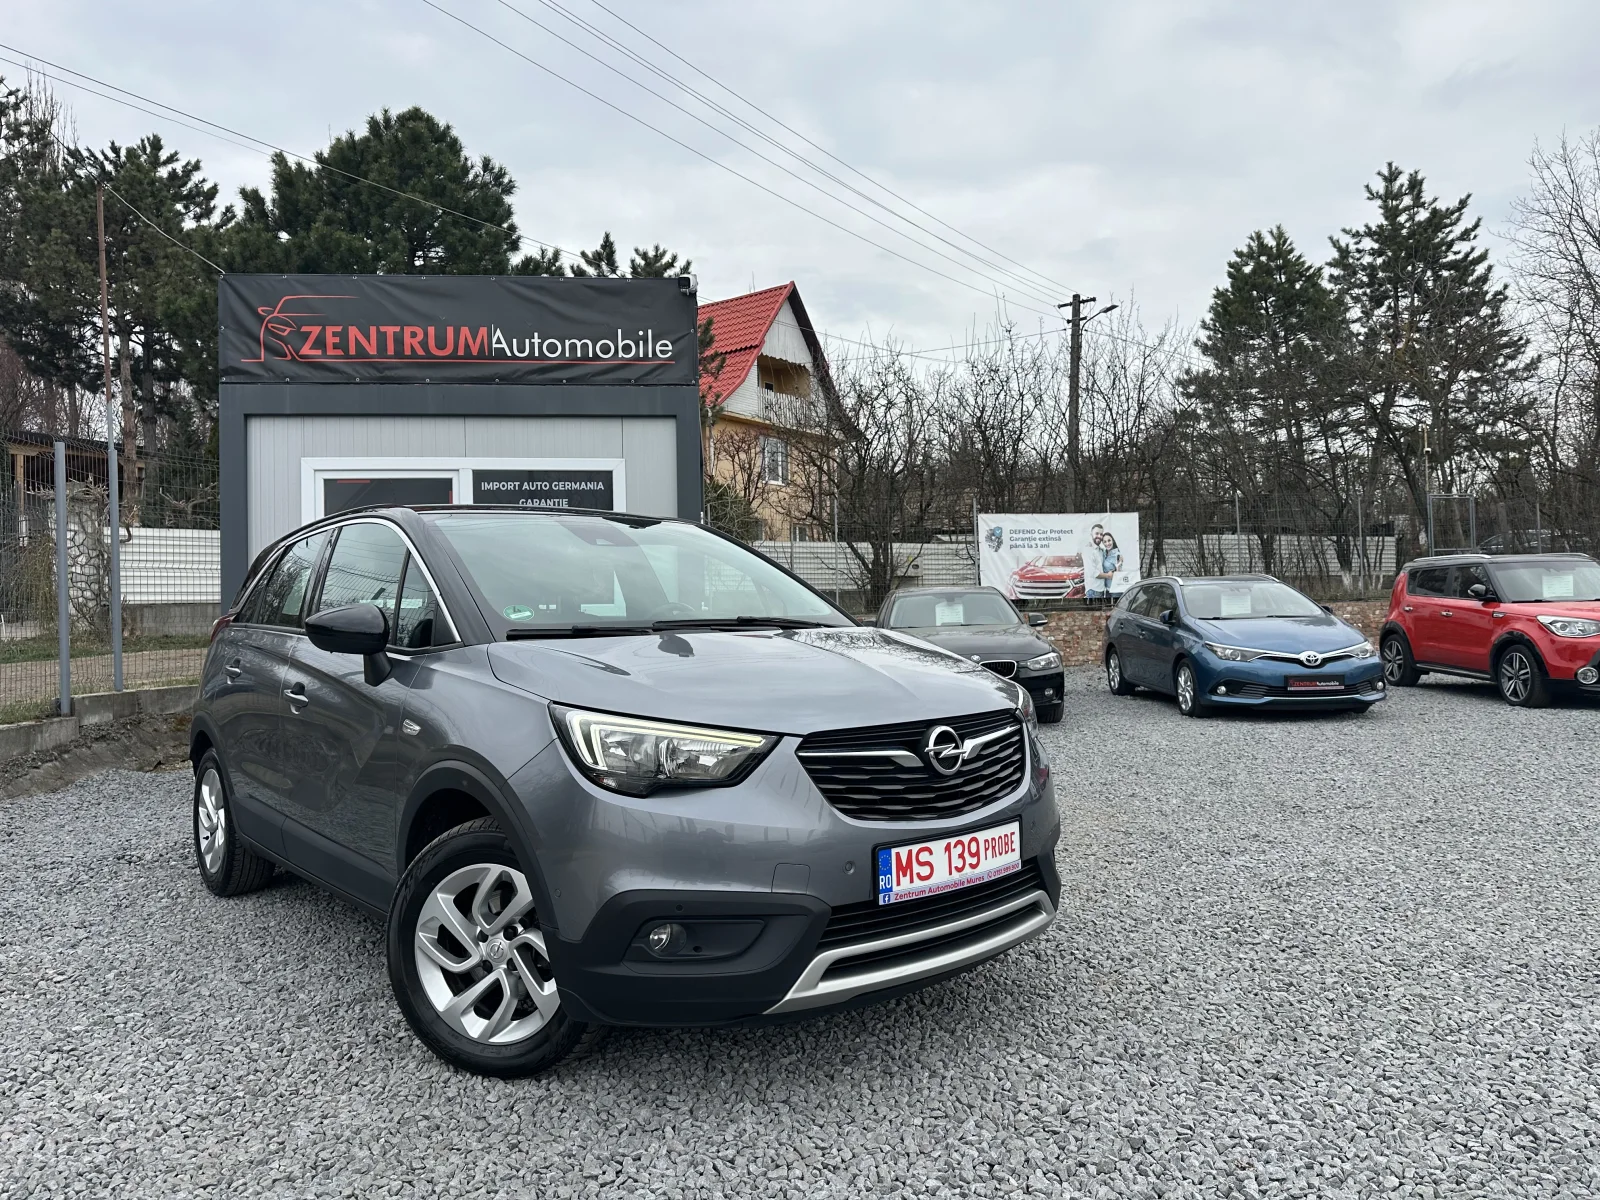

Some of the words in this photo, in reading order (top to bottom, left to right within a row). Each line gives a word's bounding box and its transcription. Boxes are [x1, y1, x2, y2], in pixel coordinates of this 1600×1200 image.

[299, 325, 489, 356] ZENTRUM
[492, 327, 673, 359] Automobile
[481, 481, 520, 491] IMPORT
[522, 481, 550, 491] AUTO
[551, 481, 604, 491] GERMANIA
[879, 874, 892, 890] RO
[895, 846, 934, 886] MS
[944, 836, 981, 876] 139
[983, 831, 1016, 860] PROBE
[894, 889, 927, 901] Zentrum
[927, 879, 966, 895] Automobile
